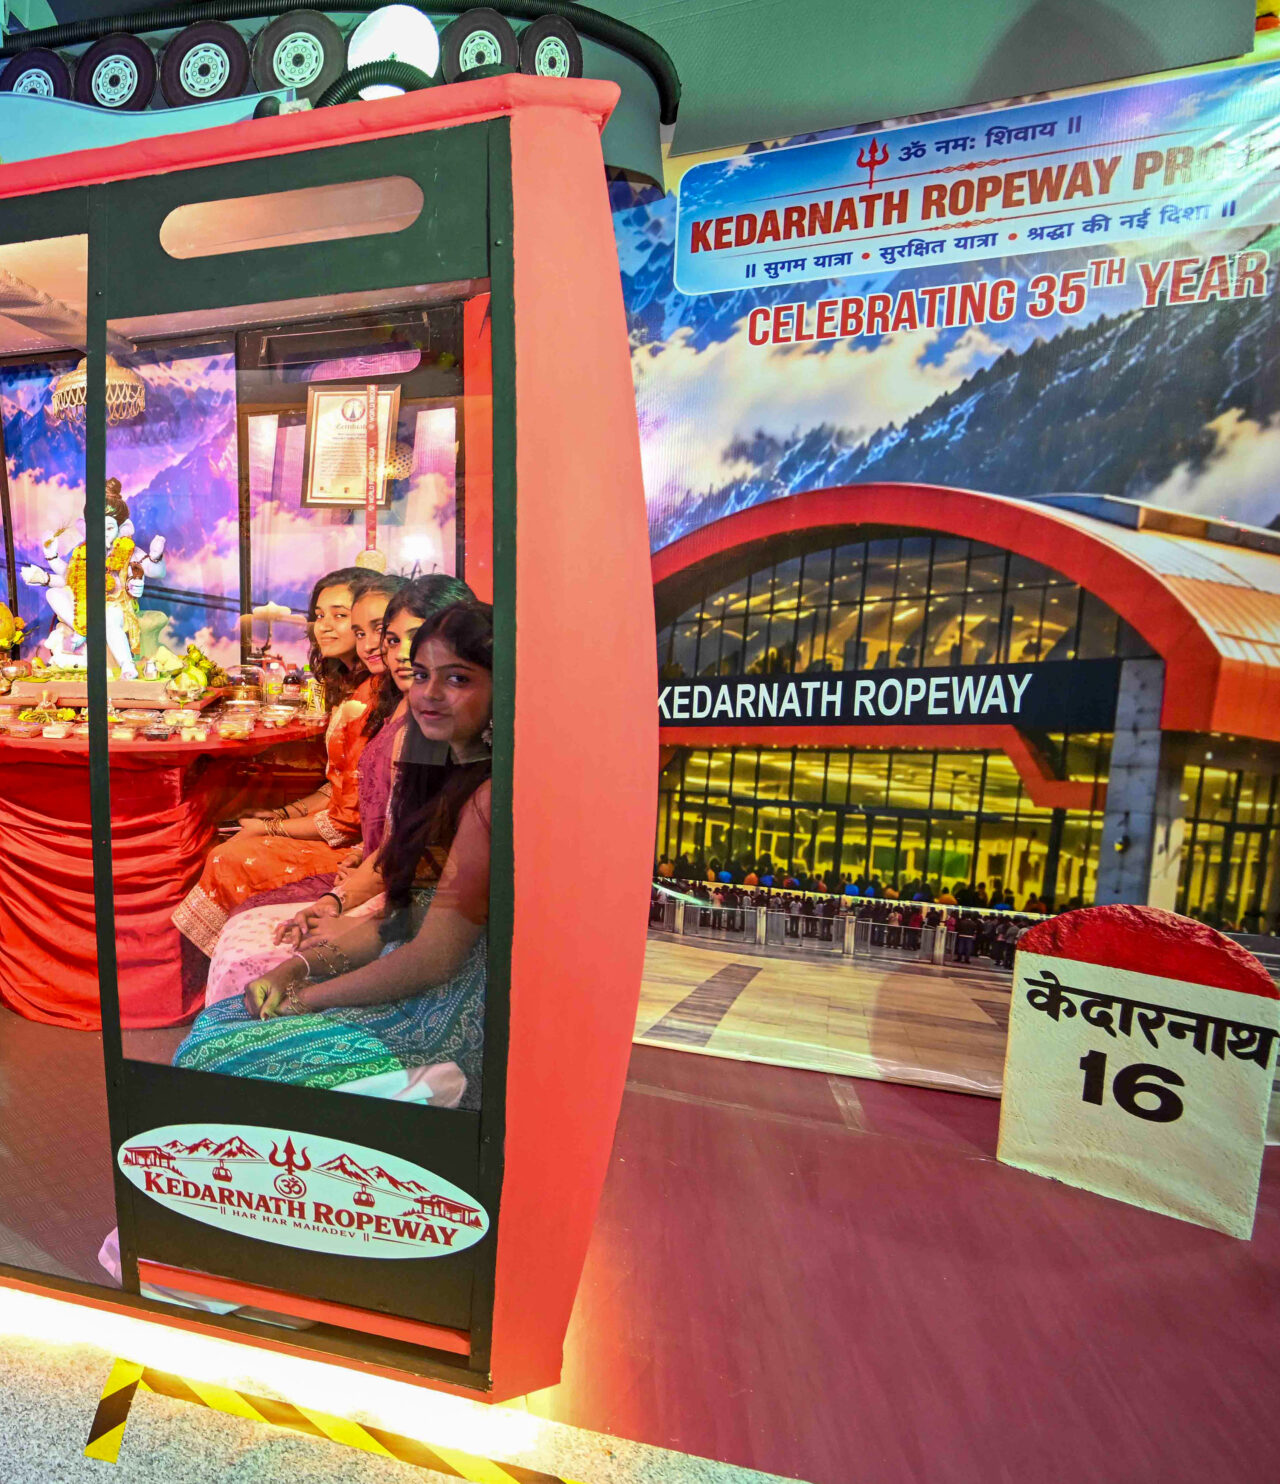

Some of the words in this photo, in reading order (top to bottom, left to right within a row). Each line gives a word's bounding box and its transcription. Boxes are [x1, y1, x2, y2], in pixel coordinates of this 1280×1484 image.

[935, 136, 975, 154] नमः
[984, 121, 1057, 148] शिवाय
[690, 188, 909, 254] KEDARNATH
[921, 155, 1122, 221] ROPEWAY
[763, 257, 806, 280] सुगम
[813, 251, 853, 269] यात्रा
[879, 236, 947, 264] सुरक्षित
[954, 232, 999, 250] यात्रा
[1027, 221, 1074, 242] श्रद्धा
[1082, 214, 1112, 234] की
[1120, 207, 1151, 229] नई
[747, 276, 1016, 347] CELEBRATING
[1136, 250, 1270, 309] YEAR
[657, 680, 843, 720] KEDARNATH
[853, 673, 1033, 717] ROPEWAY
[1023, 970, 1280, 1070] केदारनाथ
[1079, 1049, 1185, 1123] 16
[144, 1170, 307, 1221] KEDARNATH
[313, 1200, 459, 1247] ROPEWAY
[232, 1209, 257, 1220] HAR
[262, 1215, 287, 1225] HAR
[293, 1221, 357, 1239] MAHADEV
